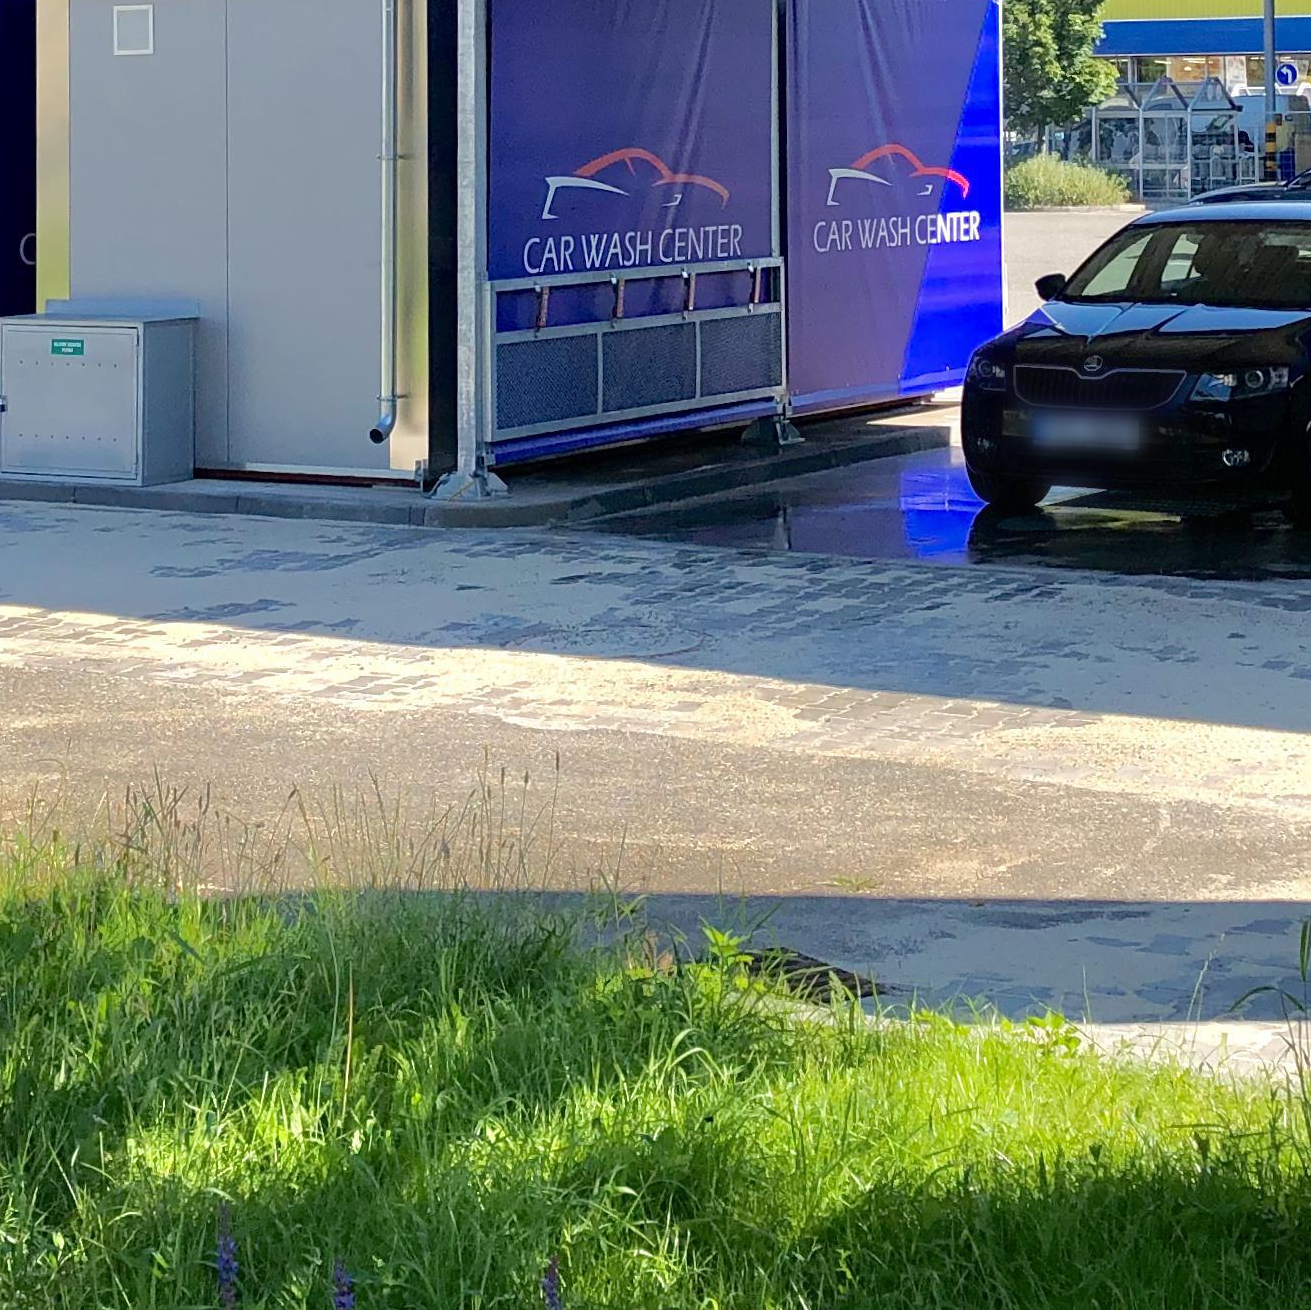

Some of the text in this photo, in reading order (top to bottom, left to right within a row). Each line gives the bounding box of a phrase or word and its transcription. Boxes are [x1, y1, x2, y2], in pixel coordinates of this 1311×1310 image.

[523, 224, 743, 274] CAR WASH CENTER
[813, 210, 981, 253] CAR WASH CENTER
